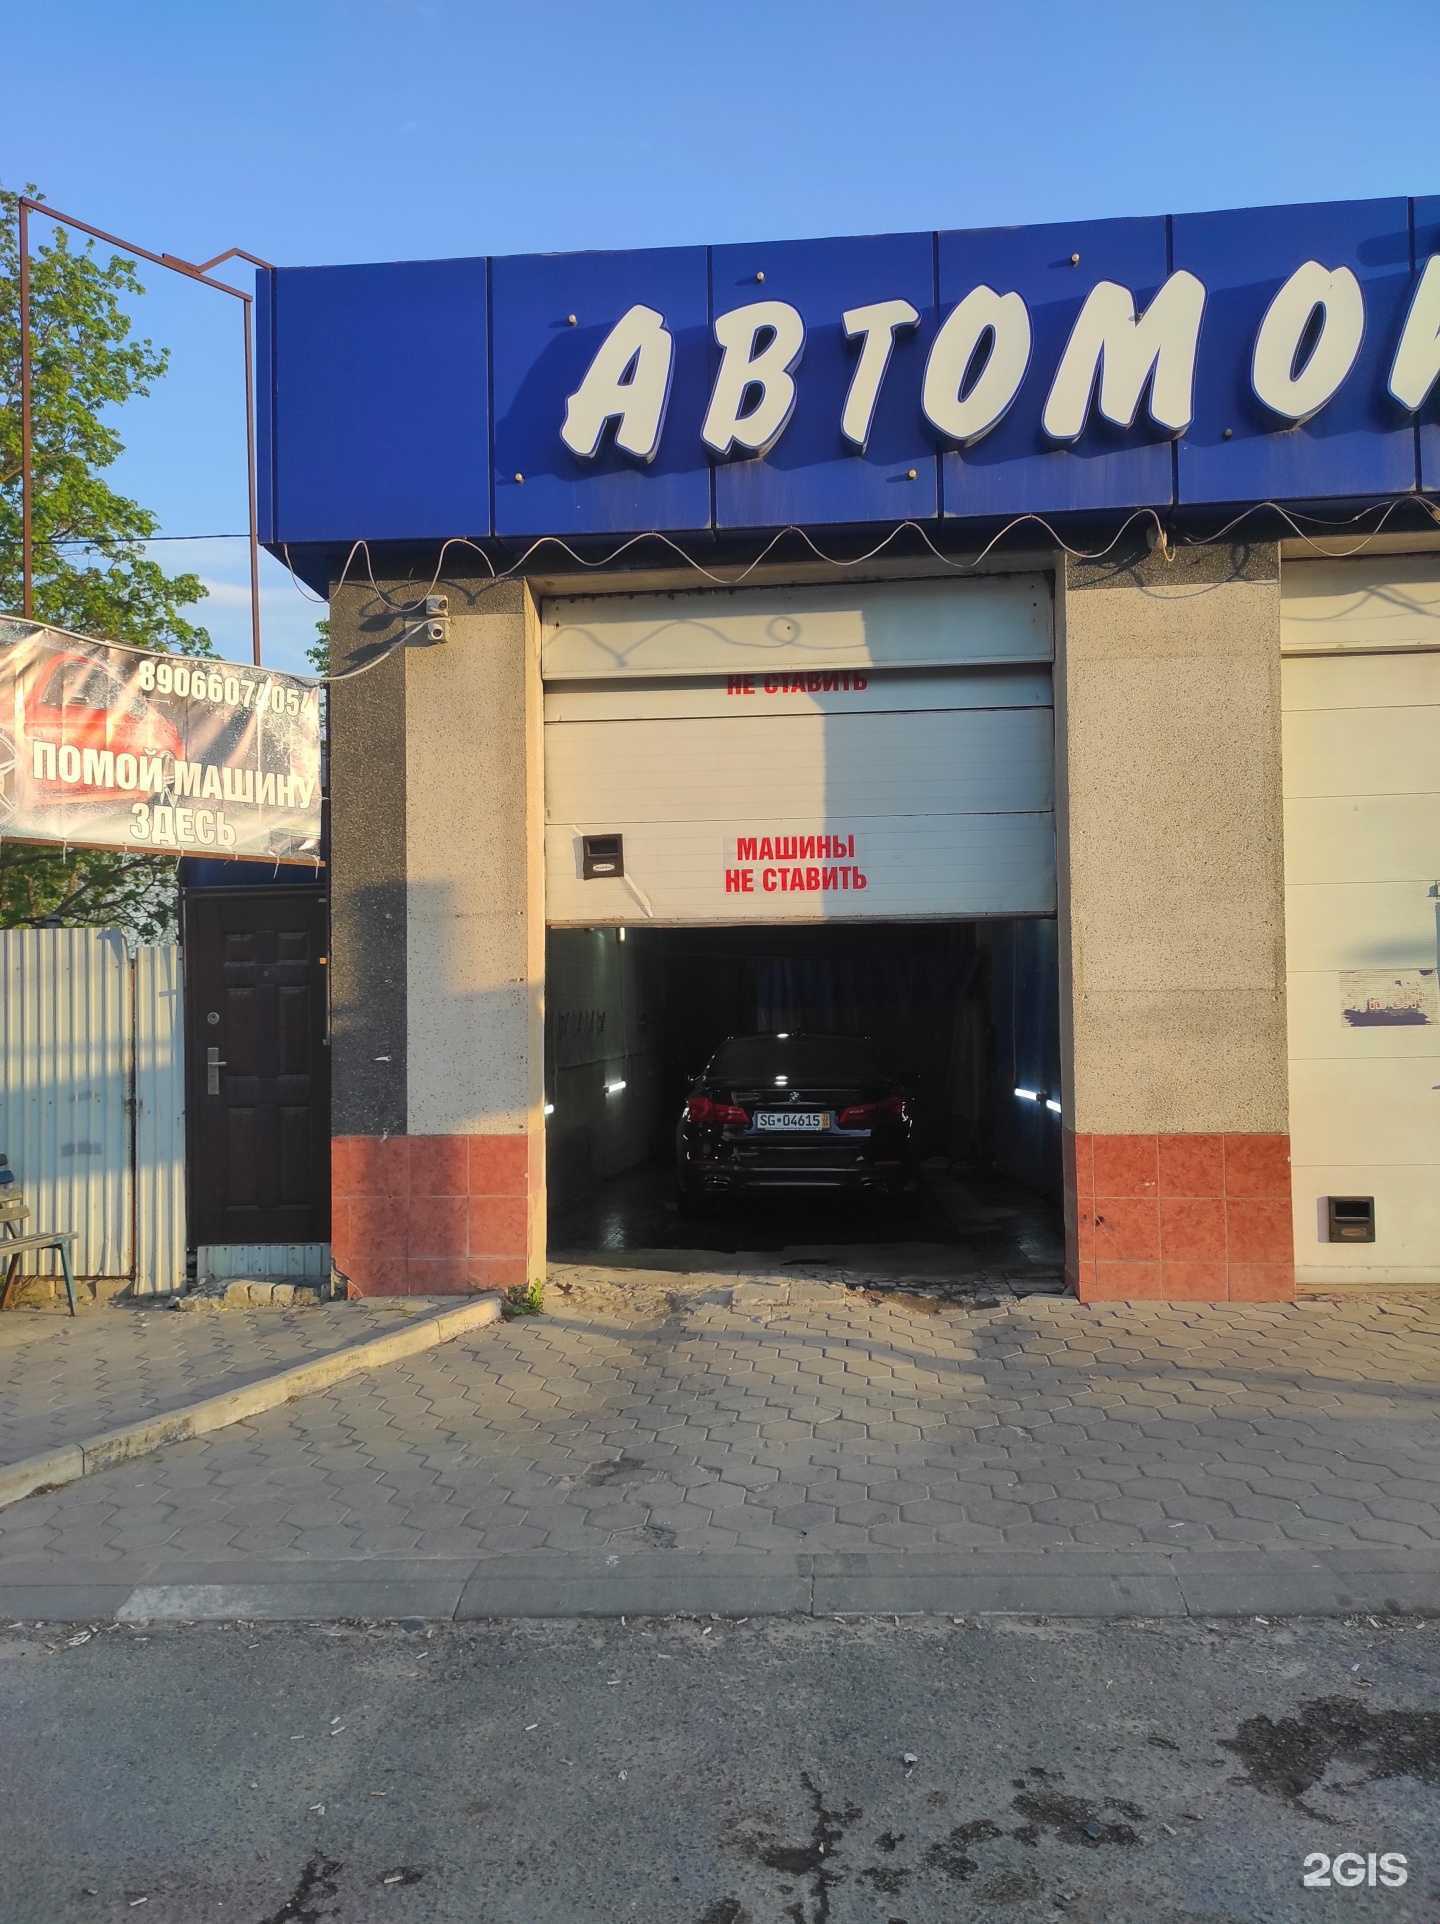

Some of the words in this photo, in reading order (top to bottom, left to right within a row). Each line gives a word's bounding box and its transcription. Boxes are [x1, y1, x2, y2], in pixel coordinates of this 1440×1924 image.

[727, 674, 755, 695] НЕ
[763, 671, 867, 694] СТАВИТЬ
[32, 740, 163, 793] ПОМОЙ
[173, 761, 315, 809] МАШИНУ
[129, 803, 237, 847] ЗДЕСЬ
[737, 835, 855, 861] МАШИНЫ
[725, 869, 754, 893] НЕ
[763, 866, 868, 892] СТАВИТЬ
